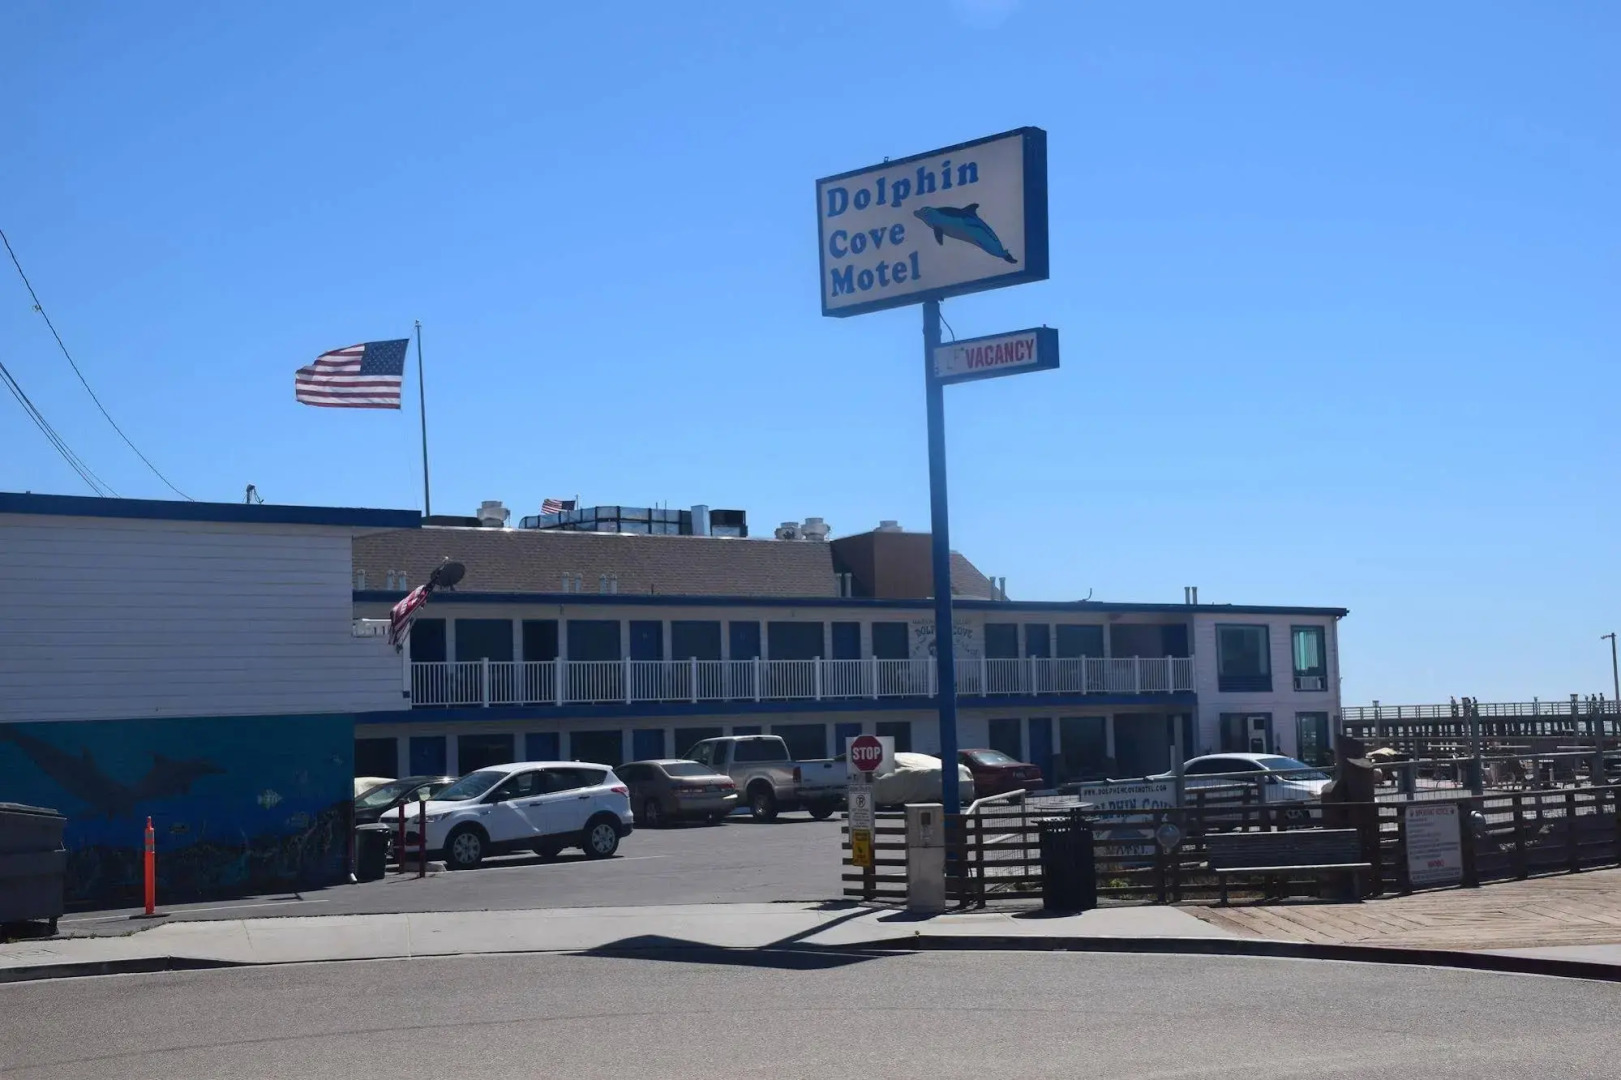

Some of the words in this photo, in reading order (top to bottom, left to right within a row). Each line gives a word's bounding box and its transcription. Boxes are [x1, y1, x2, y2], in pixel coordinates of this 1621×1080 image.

[827, 160, 979, 217] Dolphin
[829, 223, 905, 259] Cove
[831, 251, 921, 297] Motel
[965, 339, 1034, 368] VACANCY
[852, 746, 881, 760] STOP
